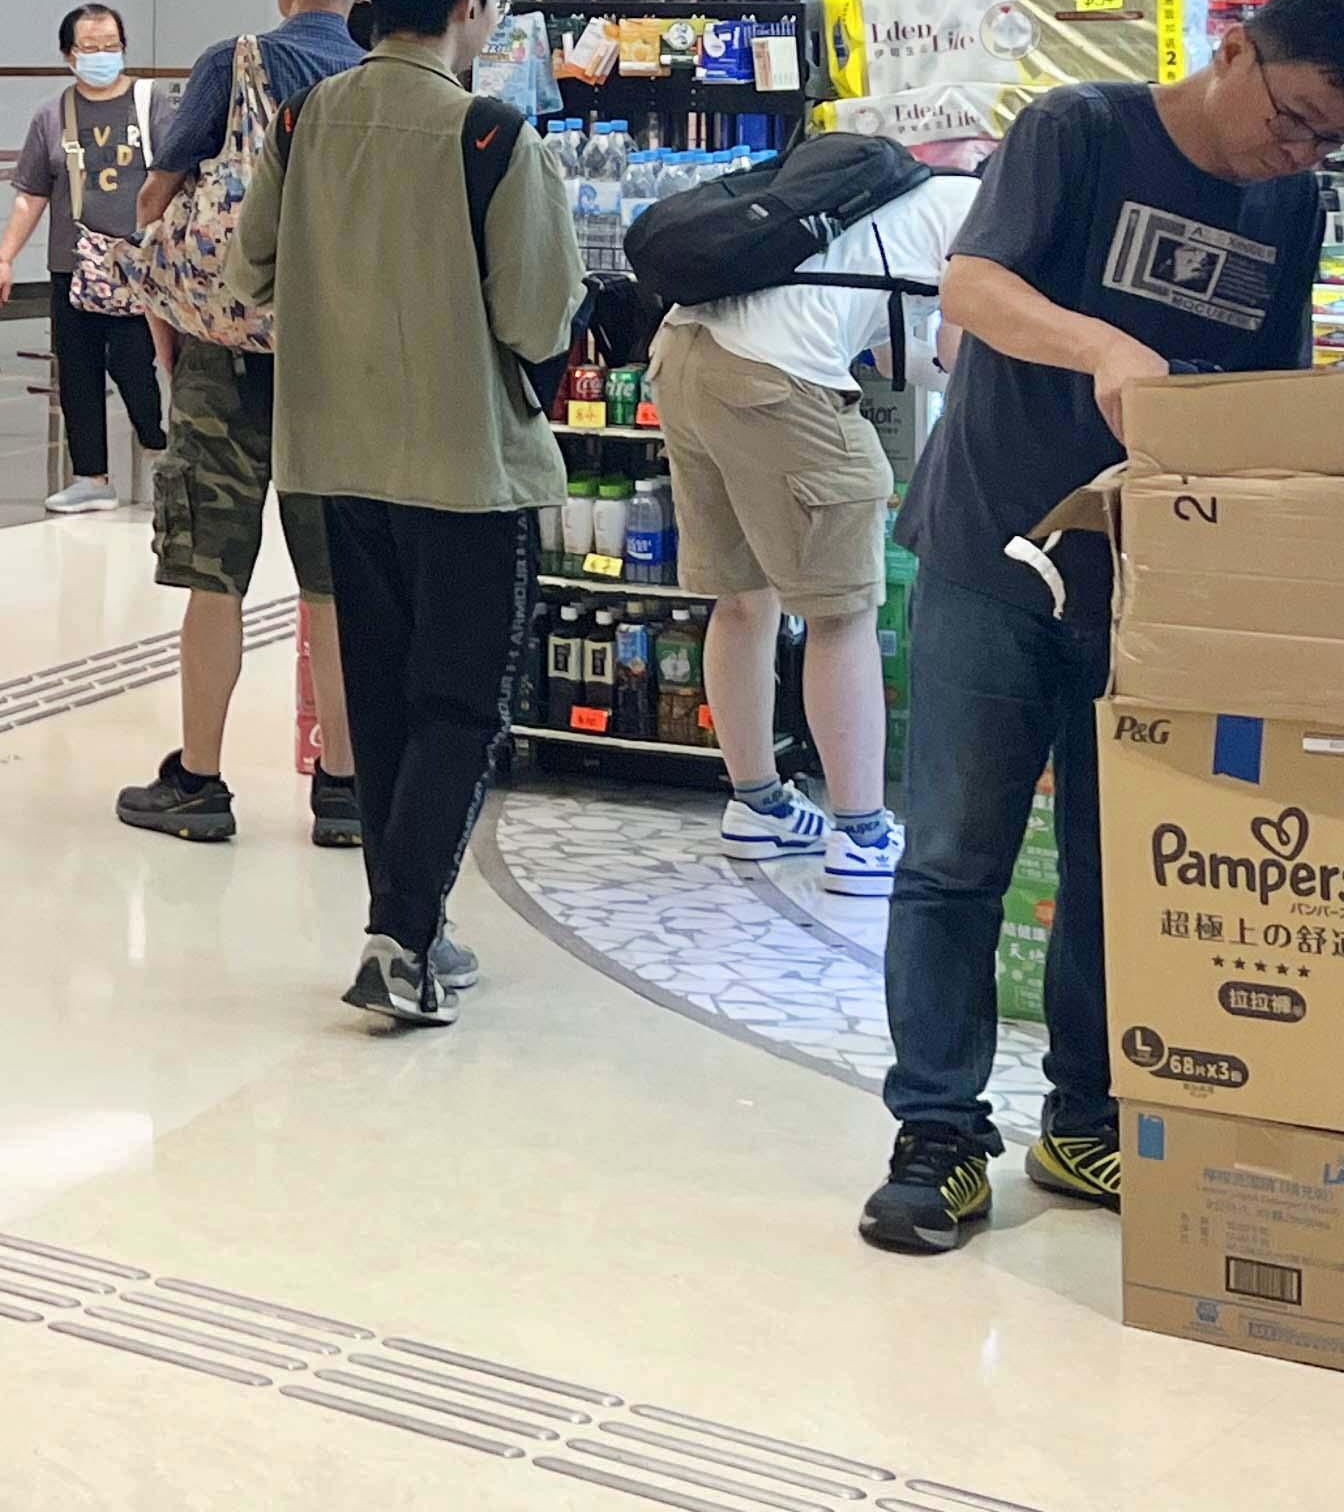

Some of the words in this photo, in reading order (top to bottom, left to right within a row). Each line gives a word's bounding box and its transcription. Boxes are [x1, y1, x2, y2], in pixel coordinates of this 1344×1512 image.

[871, 21, 932, 44] Eden
[511, 557, 529, 646] ARMOUR
[1113, 714, 1172, 745] P&G
[1152, 823, 1344, 905] Pamper
[1134, 1029, 1153, 1052] L
